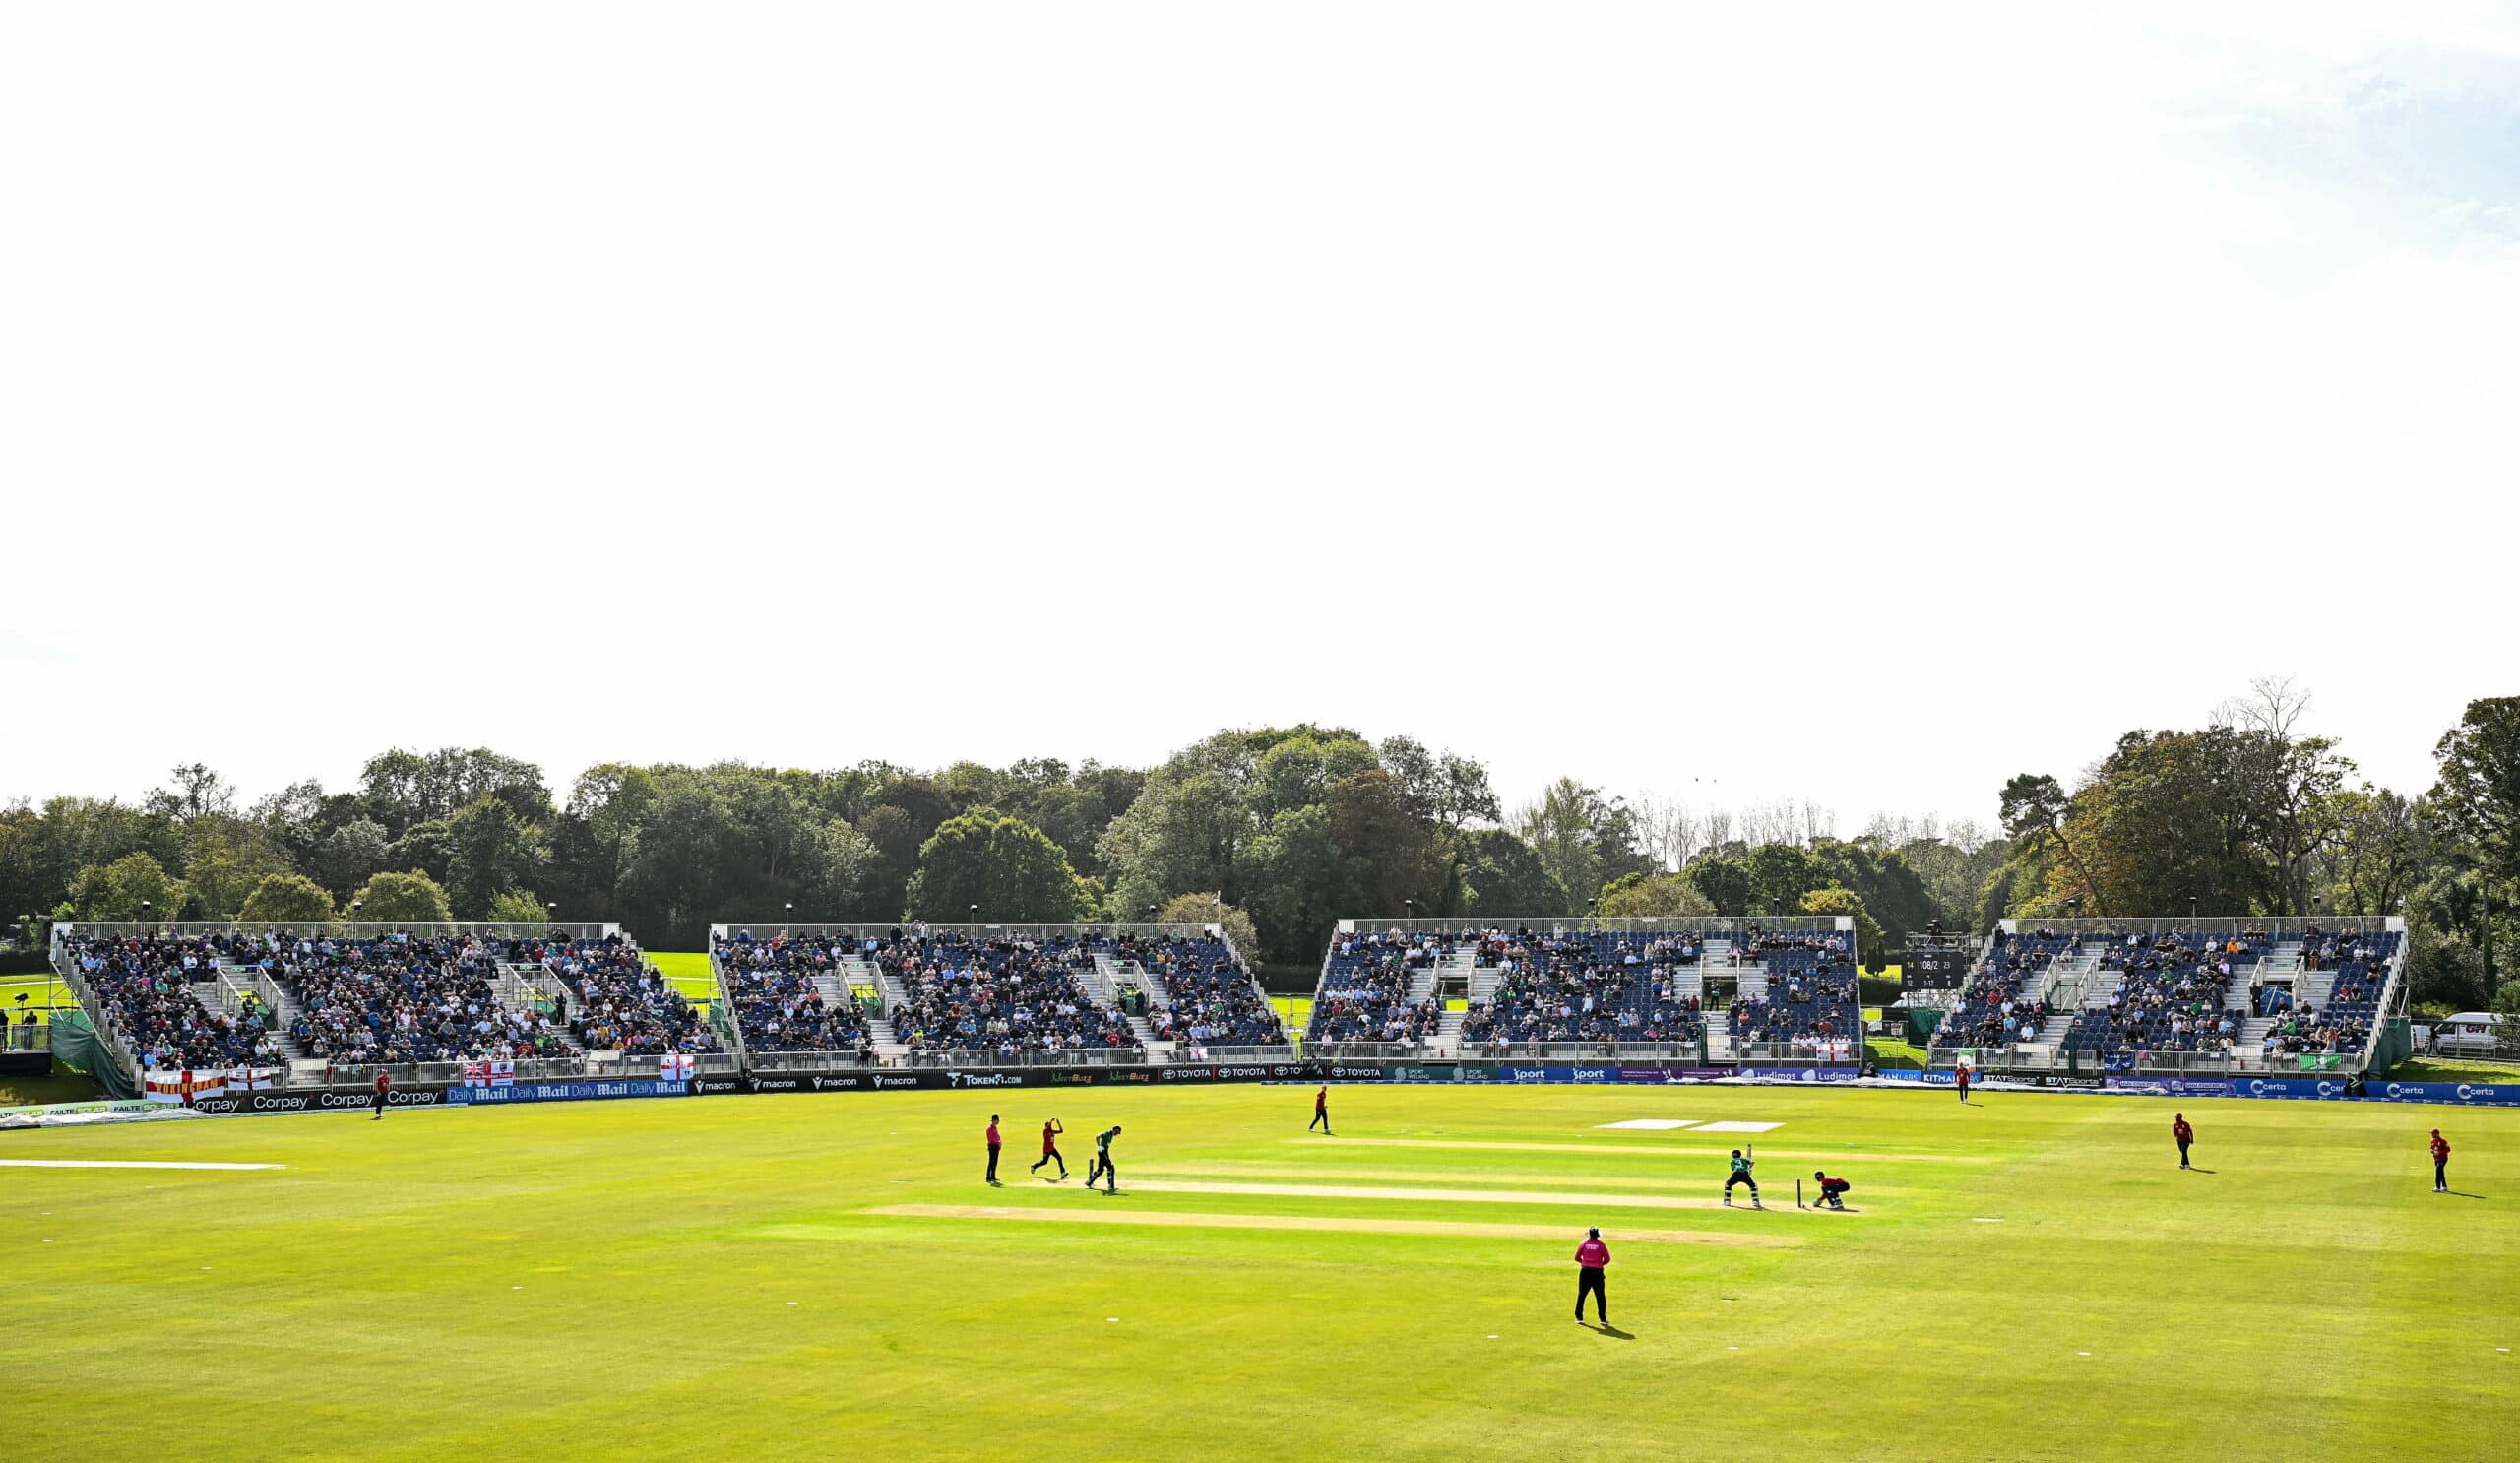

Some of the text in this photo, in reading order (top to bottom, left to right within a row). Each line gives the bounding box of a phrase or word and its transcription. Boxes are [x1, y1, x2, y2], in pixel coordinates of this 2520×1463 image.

[1920, 960, 1938, 971] 108/2
[1177, 1069, 1211, 1078] TOYOTA
[1346, 1068, 1381, 1077] TOYOTA
[1818, 1072, 1858, 1081] Ludimos
[705, 1081, 736, 1090] macron
[763, 1079, 796, 1088] macron
[824, 1077, 857, 1086] macron
[884, 1076, 917, 1085] macron
[512, 1085, 569, 1100] Daily Mail
[572, 1083, 628, 1098] Daily Mail
[630, 1081, 686, 1095] Daily Mail
[2470, 1087, 2494, 1096] certa
[387, 1090, 438, 1106] Corpay
[448, 1087, 508, 1104] Daily Mail
[254, 1096, 307, 1110] Corpay
[321, 1093, 374, 1109] Corpay
